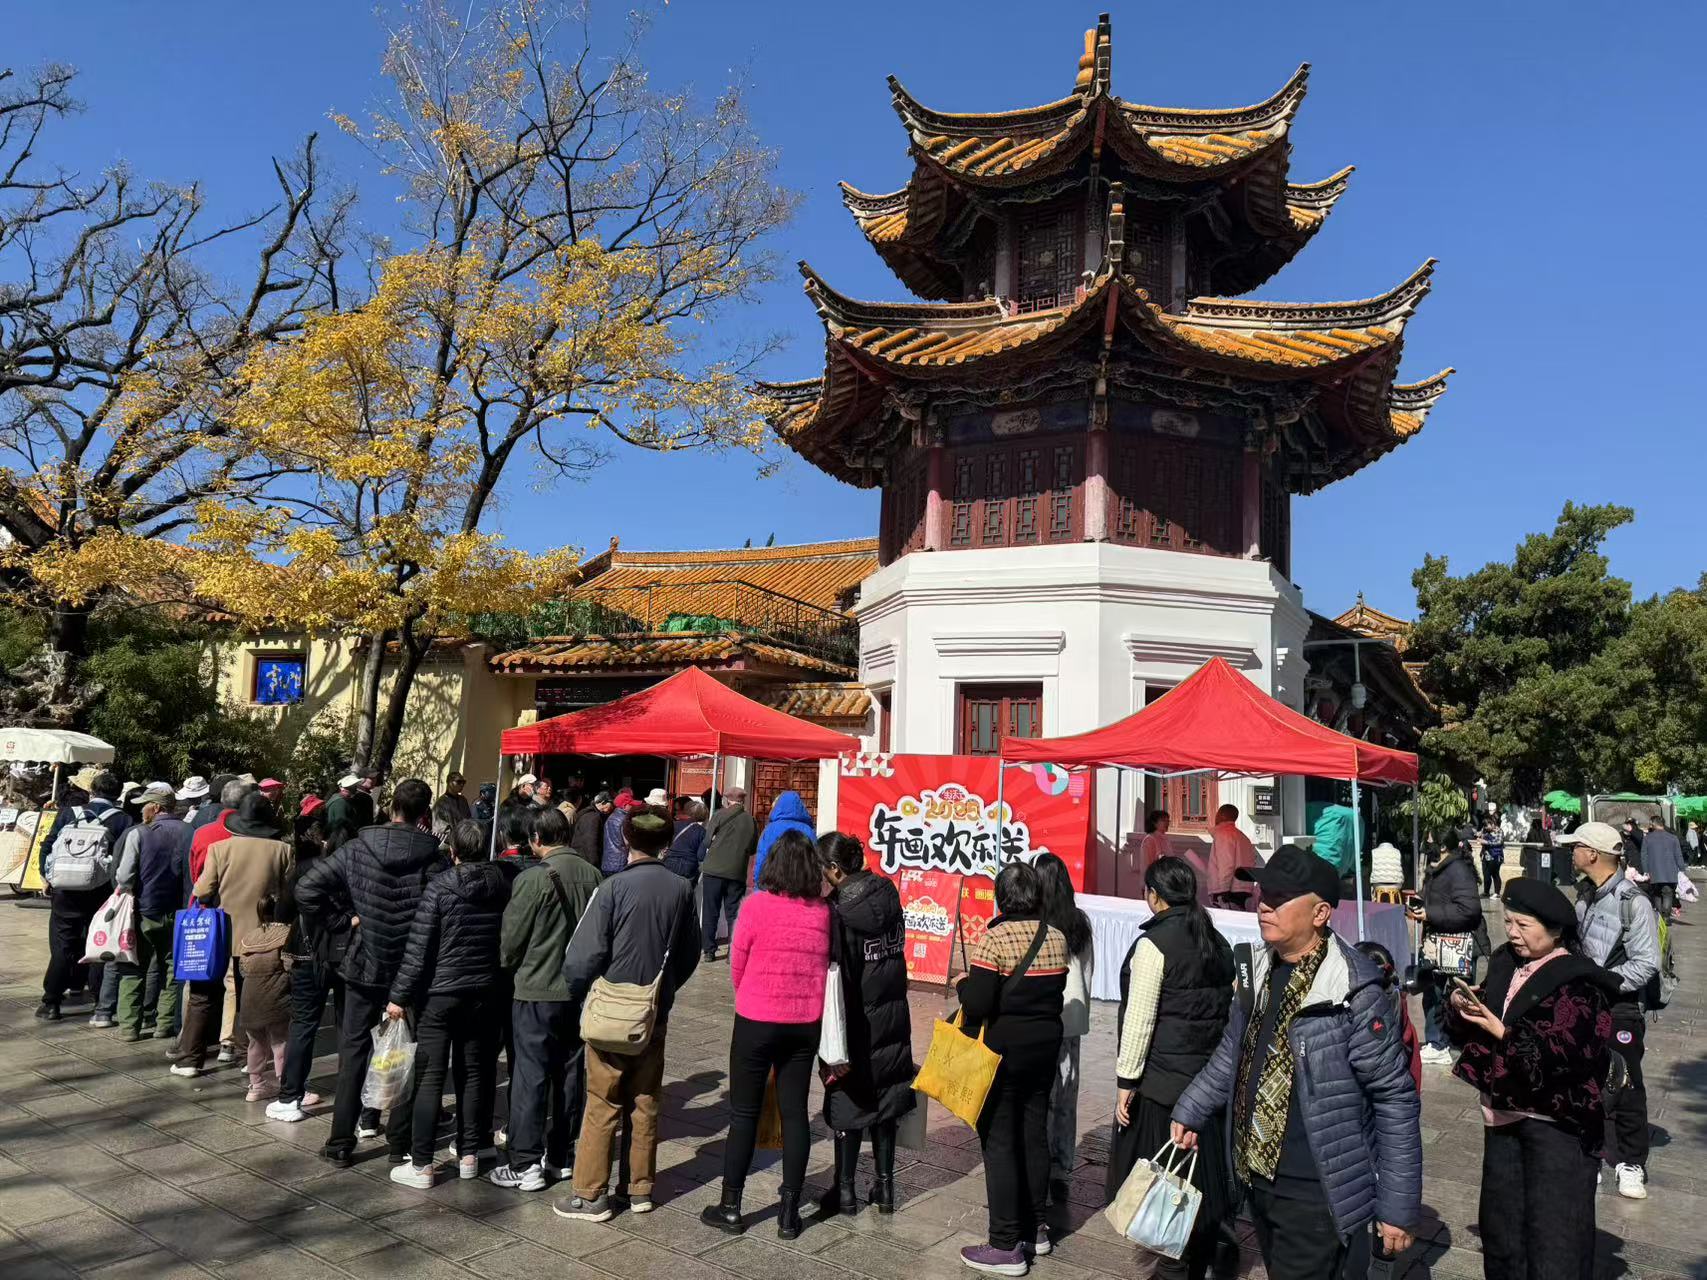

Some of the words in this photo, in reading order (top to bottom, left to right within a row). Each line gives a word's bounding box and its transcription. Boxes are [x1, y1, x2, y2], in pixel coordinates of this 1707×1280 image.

[874, 808, 1025, 870] 年画欢乐送
